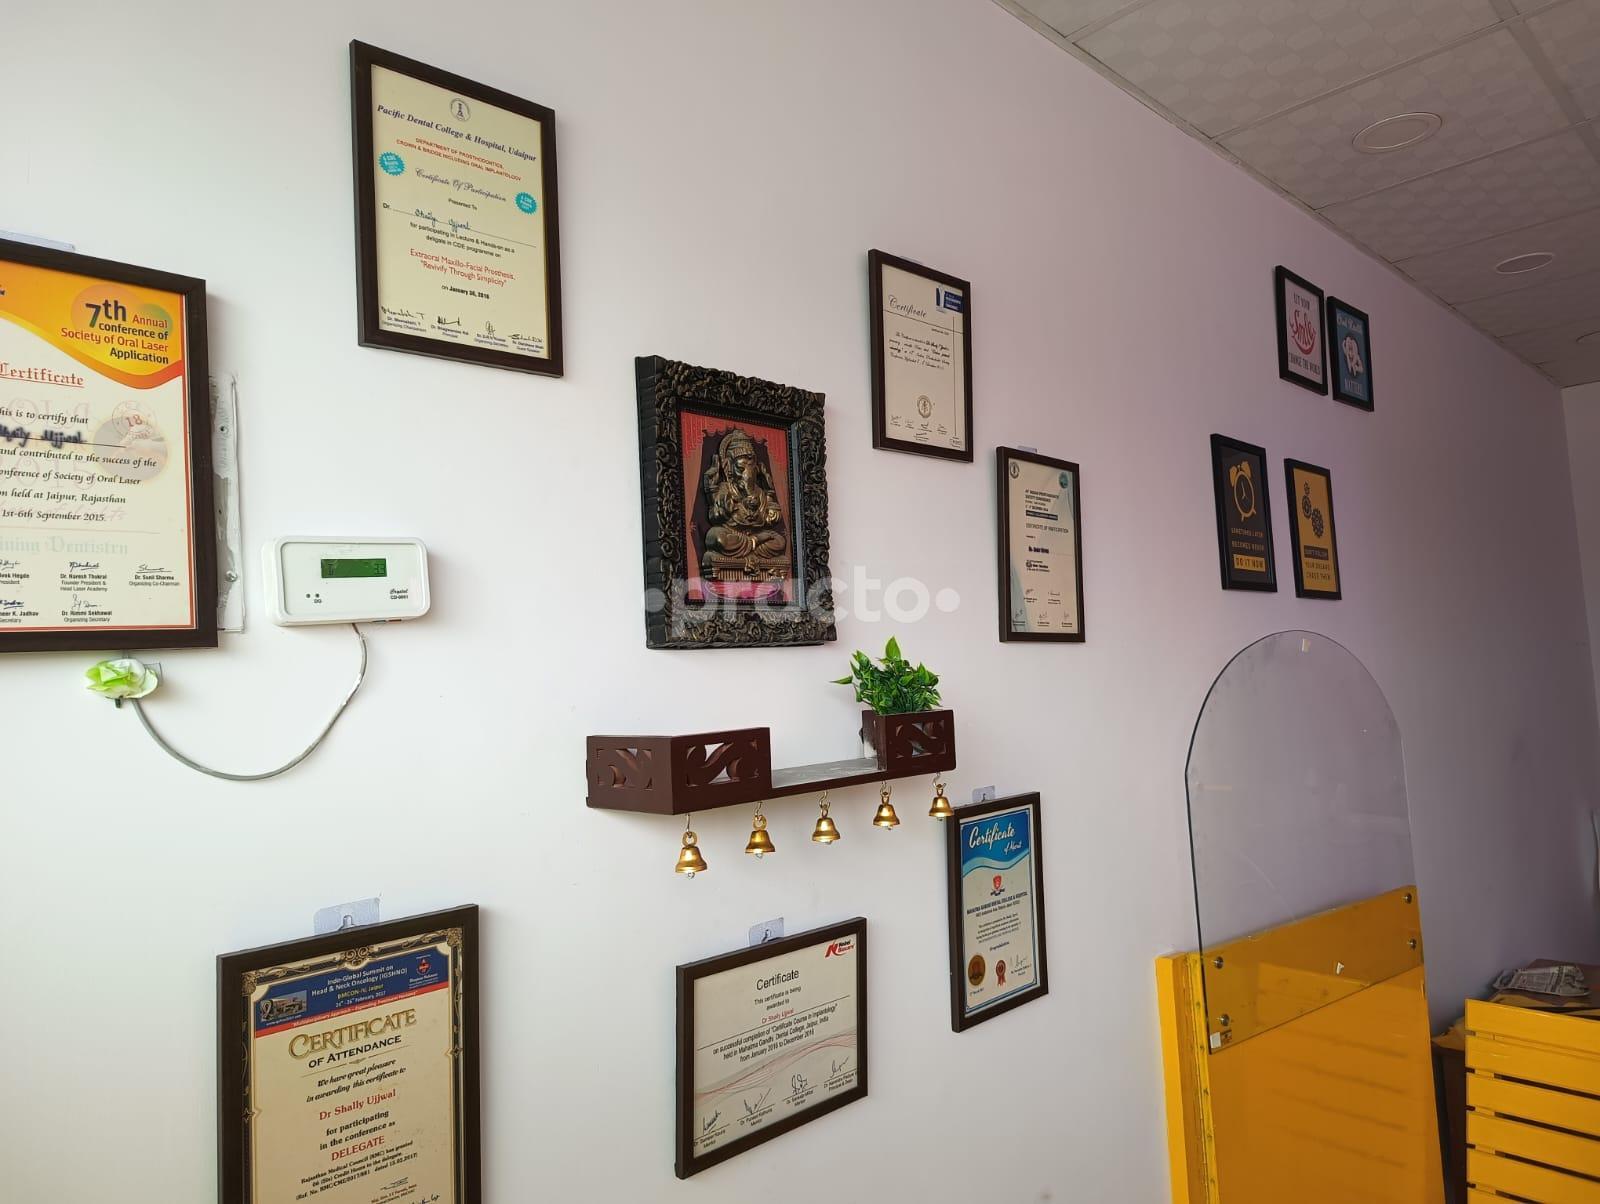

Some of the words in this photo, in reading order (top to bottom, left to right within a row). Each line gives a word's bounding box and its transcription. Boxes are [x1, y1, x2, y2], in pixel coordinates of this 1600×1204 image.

[378, 105, 405, 120] Pacific
[406, 114, 434, 129] Dental
[436, 124, 464, 139] College
[466, 134, 473, 142] &
[474, 136, 506, 153] Hospital,
[508, 147, 537, 162] Udaipur
[416, 138, 450, 152] DEPARTMENT
[416, 168, 450, 185] Certificate
[464, 182, 507, 202] Participation
[410, 248, 440, 262] Extraoral
[441, 256, 483, 273] Maxillo-Facial
[450, 267, 476, 281] Through
[85, 299, 127, 328] 7th
[132, 314, 168, 329] Annual
[888, 294, 927, 318] Certificate
[61, 327, 101, 345] Society
[104, 334, 115, 345] of
[117, 336, 139, 348] Oral
[141, 341, 168, 352] Laser
[99, 321, 156, 339] conference
[158, 331, 168, 341] of
[110, 347, 169, 365] Application
[0, 362, 84, 386] Certificate
[16, 409, 23, 418] is
[26, 411, 35, 419] to
[38, 412, 67, 425] certify
[70, 414, 89, 425] that
[19, 448, 72, 461] contributed
[75, 453, 84, 461] to
[86, 451, 101, 463] the
[102, 456, 131, 466] success
[132, 457, 143, 468] of
[144, 458, 157, 468] the
[0, 468, 41, 481] onference
[42, 469, 52, 482] of
[54, 471, 84, 484] Society
[86, 473, 96, 484] of
[97, 475, 117, 484] Oral
[119, 477, 142, 485] Laser
[11, 488, 32, 499] held
[34, 491, 44, 499] at
[46, 491, 77, 502] Jaipur,
[81, 494, 126, 505] Rajasthan
[2, 509, 33, 519] 1st-6th
[36, 511, 82, 523] September
[84, 513, 107, 522] 2015.
[969, 822, 1016, 851] Certificate
[362, 967, 385, 979] Summit
[756, 969, 800, 991] Certificate
[312, 986, 328, 997] Head
[329, 984, 335, 992] &
[336, 981, 351, 991] Neck
[351, 974, 379, 988] Oncology
[288, 1009, 418, 1060] CERTIFICATE
[720, 1038, 743, 1053] successful
[309, 1057, 326, 1069] OF
[326, 1035, 402, 1063] ATTENDANCE
[307, 1094, 314, 1103] in
[315, 1084, 350, 1101] awarding
[353, 1078, 365, 1089] this
[366, 1069, 399, 1086] certificate
[400, 1067, 406, 1075] to
[318, 1077, 329, 1088] We
[330, 1074, 347, 1085] have
[348, 1068, 367, 1081] great
[367, 1059, 397, 1075] pleasure
[319, 1110, 331, 1121] Dr
[334, 1100, 365, 1117] Shally
[367, 1089, 397, 1106] Ujjwal
[326, 1127, 338, 1137] for
[339, 1110, 390, 1134] participating
[320, 1142, 328, 1151] in
[330, 1137, 343, 1146] the
[345, 1123, 387, 1143] conference
[331, 1136, 385, 1161] DELEGATE
